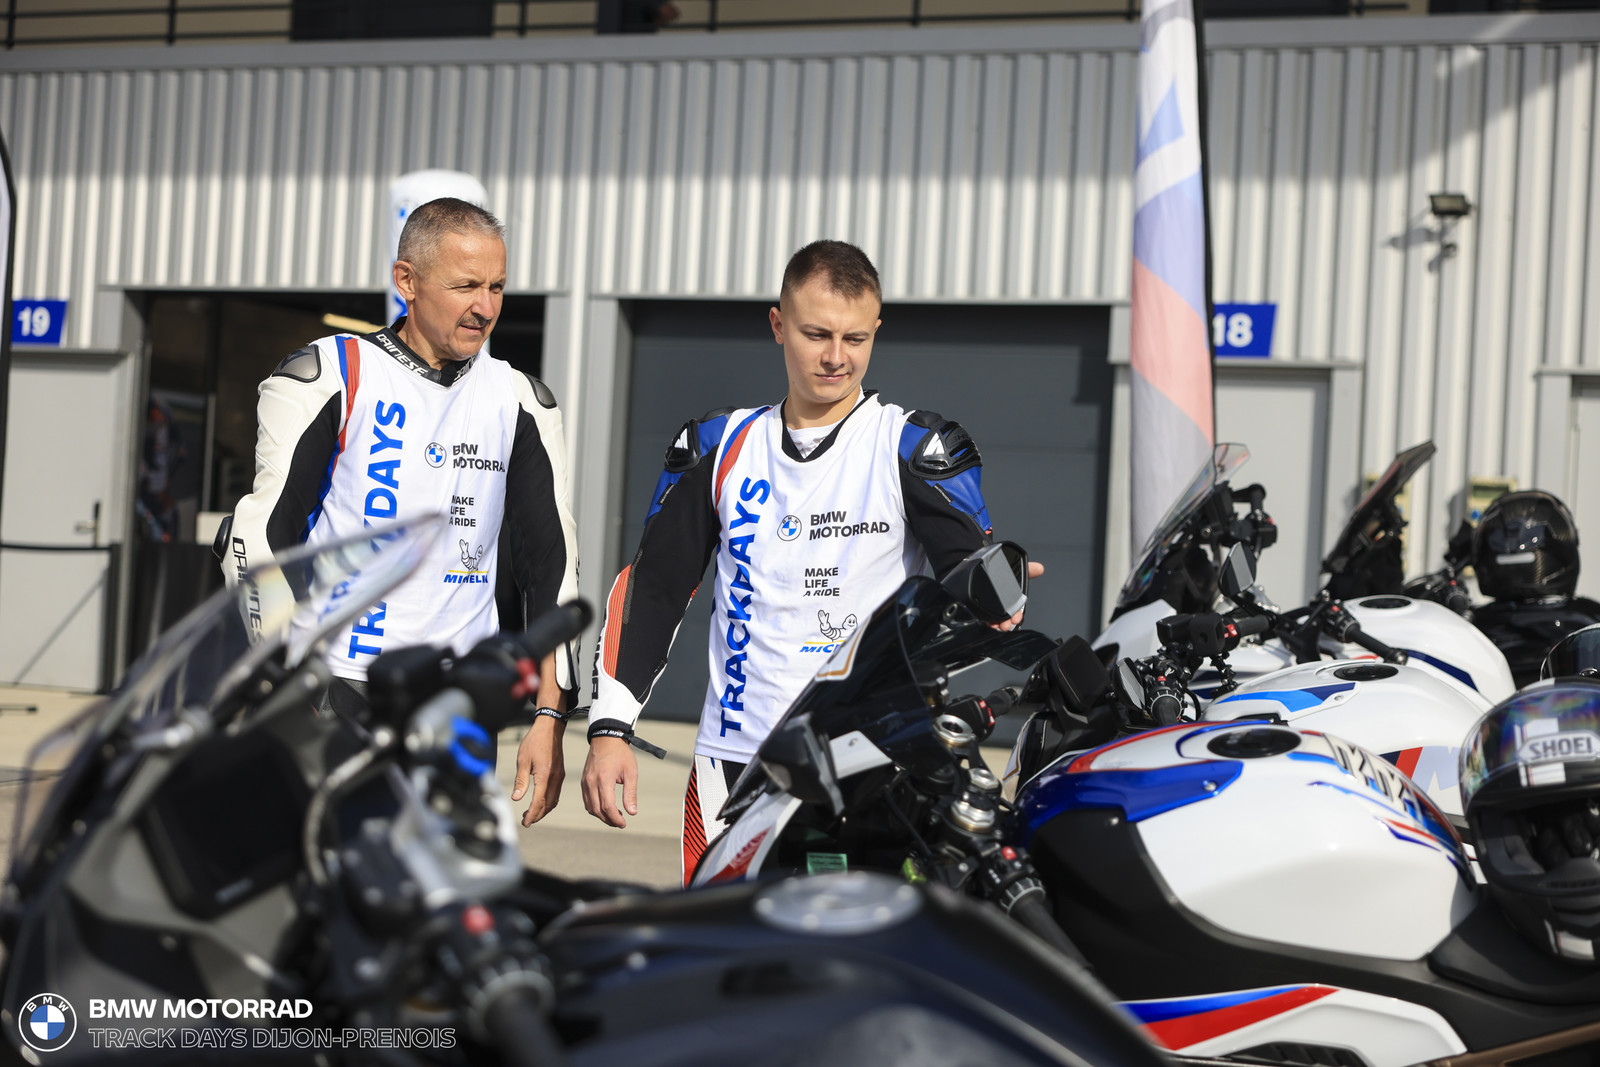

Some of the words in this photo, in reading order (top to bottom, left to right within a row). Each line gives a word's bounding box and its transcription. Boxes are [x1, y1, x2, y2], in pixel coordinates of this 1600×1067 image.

[18, 306, 51, 337] 19
[1213, 312, 1254, 349] 18
[375, 333, 429, 376] DAINESE
[453, 456, 506, 473] MOTORRA
[455, 517, 477, 528] RIDE
[810, 510, 847, 526] BMW
[347, 399, 407, 660] TRDAYS
[809, 521, 890, 541] MOTORRAD
[443, 573, 489, 584] MIELI
[804, 567, 839, 577] MAKE
[804, 579, 829, 588] LIFE
[813, 588, 840, 597] RIDE
[719, 476, 771, 738] TRACKDAYS
[1529, 736, 1593, 761] SHOEI
